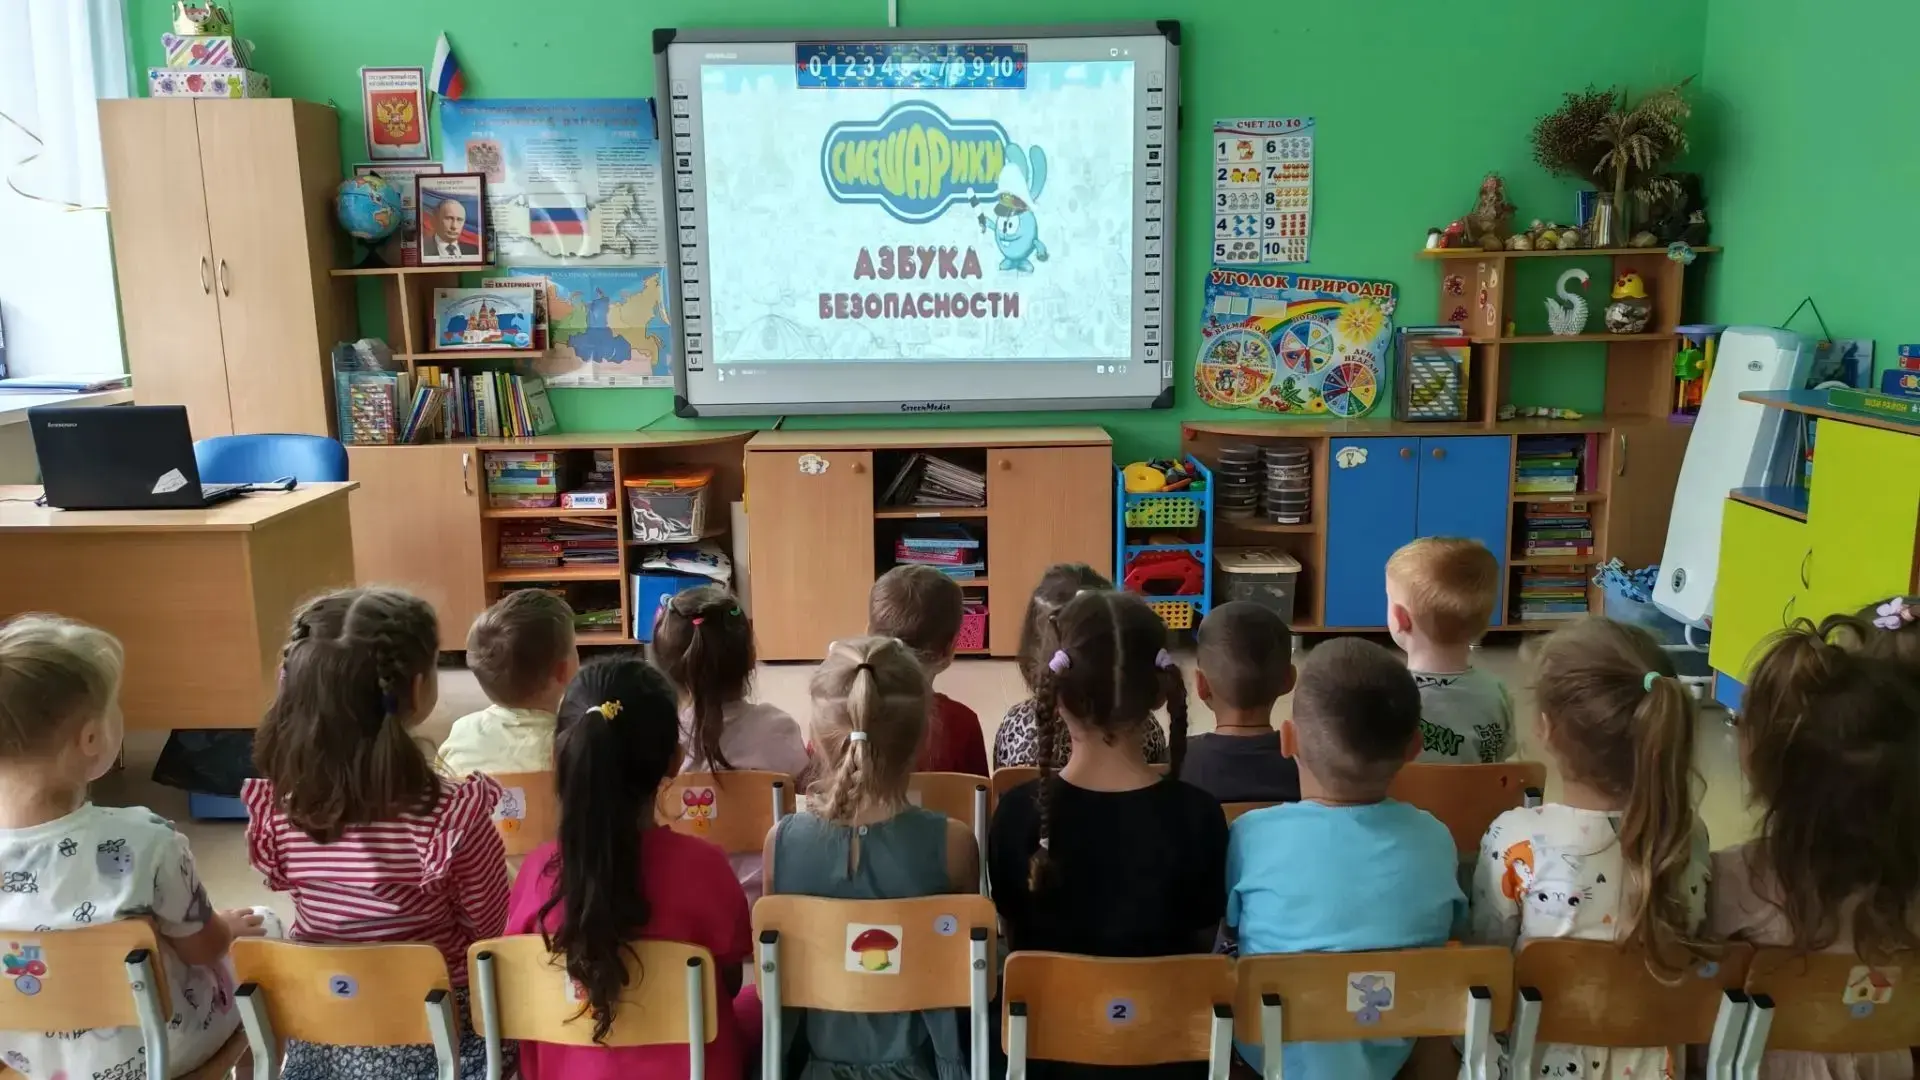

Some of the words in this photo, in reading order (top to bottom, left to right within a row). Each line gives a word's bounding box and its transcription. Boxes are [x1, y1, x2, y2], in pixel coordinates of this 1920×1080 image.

[809, 56, 822, 77] 0
[827, 57, 837, 77] 1
[845, 56, 857, 77] 2
[863, 56, 875, 77] 3
[881, 56, 894, 76] 4
[936, 56, 948, 76] 7
[972, 56, 985, 76] 9
[990, 56, 1013, 77] 10
[1267, 120, 1282, 129] ДО
[1286, 119, 1301, 128] 10
[1218, 143, 1226, 155] 1
[1266, 141, 1276, 153] 6
[832, 123, 1005, 200] СМЕШАРИКИ
[1217, 168, 1228, 181] 2
[1266, 166, 1276, 179] 7
[1217, 193, 1227, 206] 3
[1265, 192, 1275, 205] 8
[1216, 218, 1227, 231] 4
[1265, 217, 1275, 229] 9
[1216, 244, 1226, 256] 5
[1264, 242, 1280, 255] 10
[853, 246, 983, 281] АЗБУКА
[1211, 269, 1289, 290] УГОЛОК
[1297, 277, 1393, 298] ПРИРОДЫ
[818, 291, 1020, 320] БЕЗОПАСНОСТИ
[943, 921, 950, 931] 2
[336, 980, 351, 994] 2
[1112, 1005, 1126, 1018] 2
